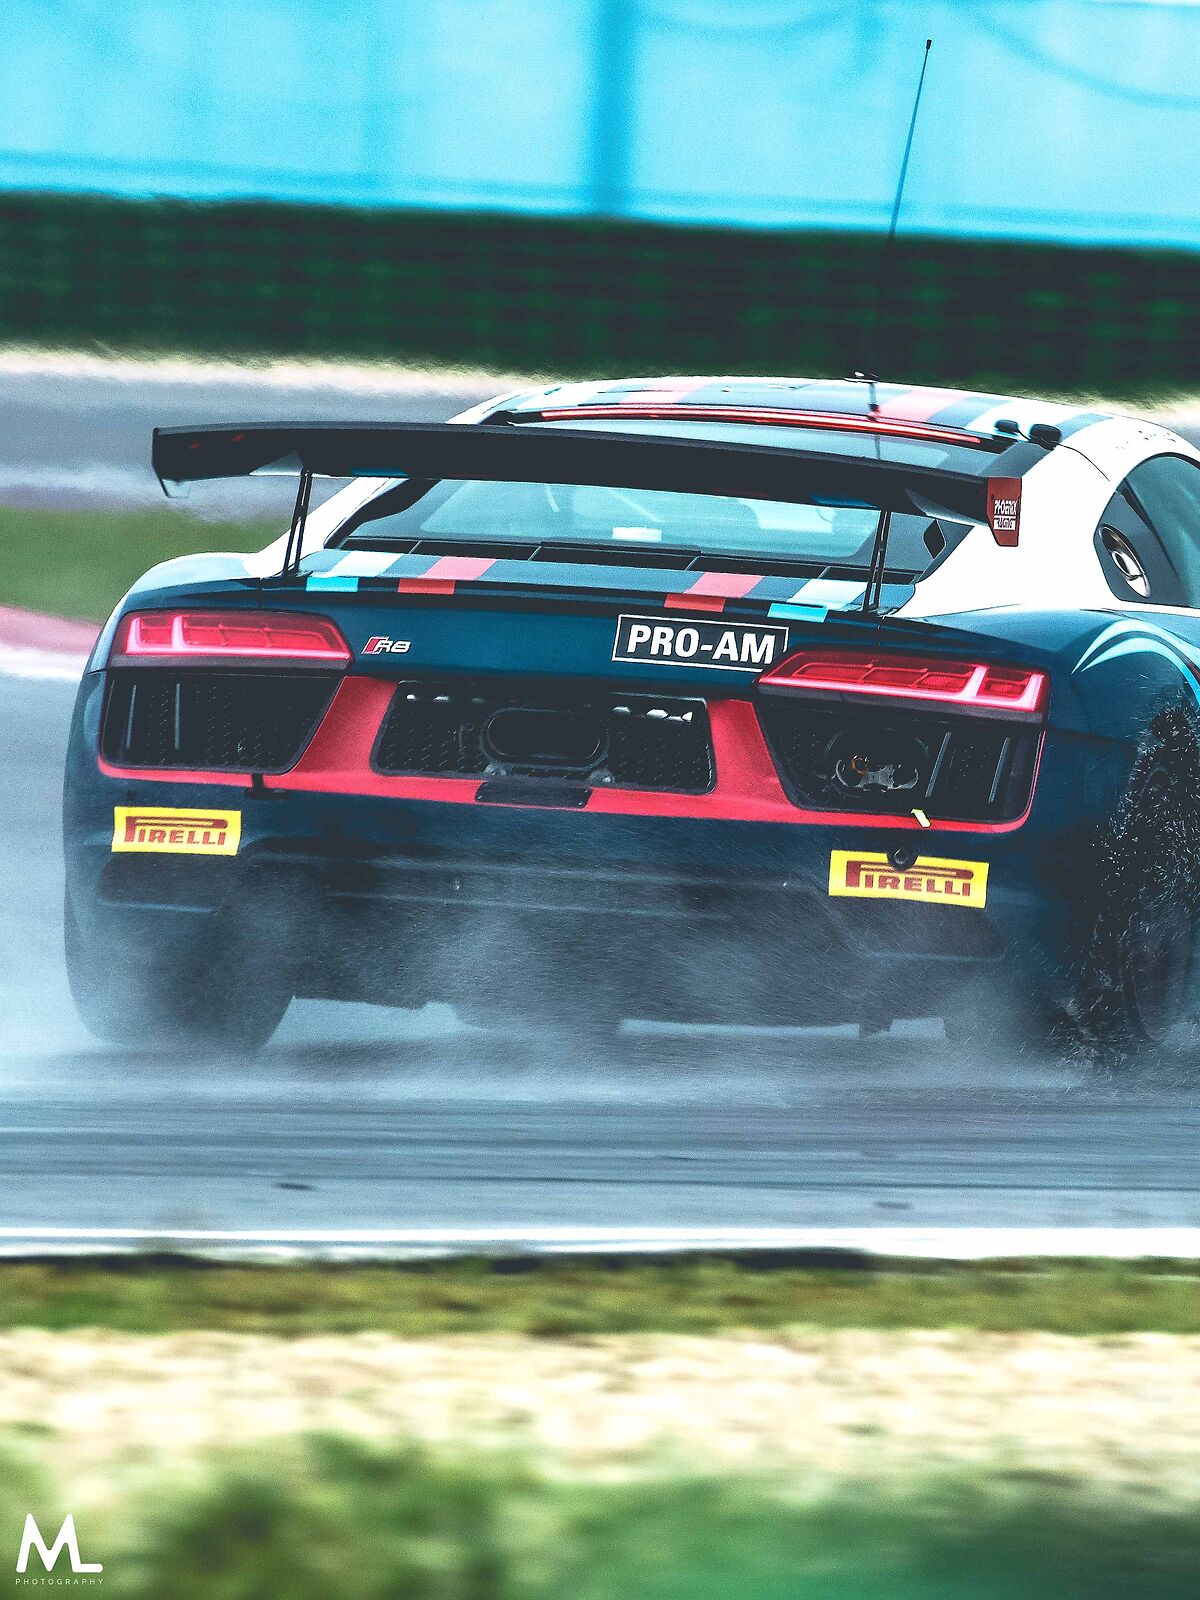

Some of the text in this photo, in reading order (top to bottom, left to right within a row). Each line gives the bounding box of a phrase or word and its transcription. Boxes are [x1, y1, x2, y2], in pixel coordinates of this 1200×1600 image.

[369, 638, 412, 653] R8
[626, 623, 776, 665] PRO-AM
[124, 815, 228, 846] PIRELLI
[845, 859, 974, 897] PIRELLI
